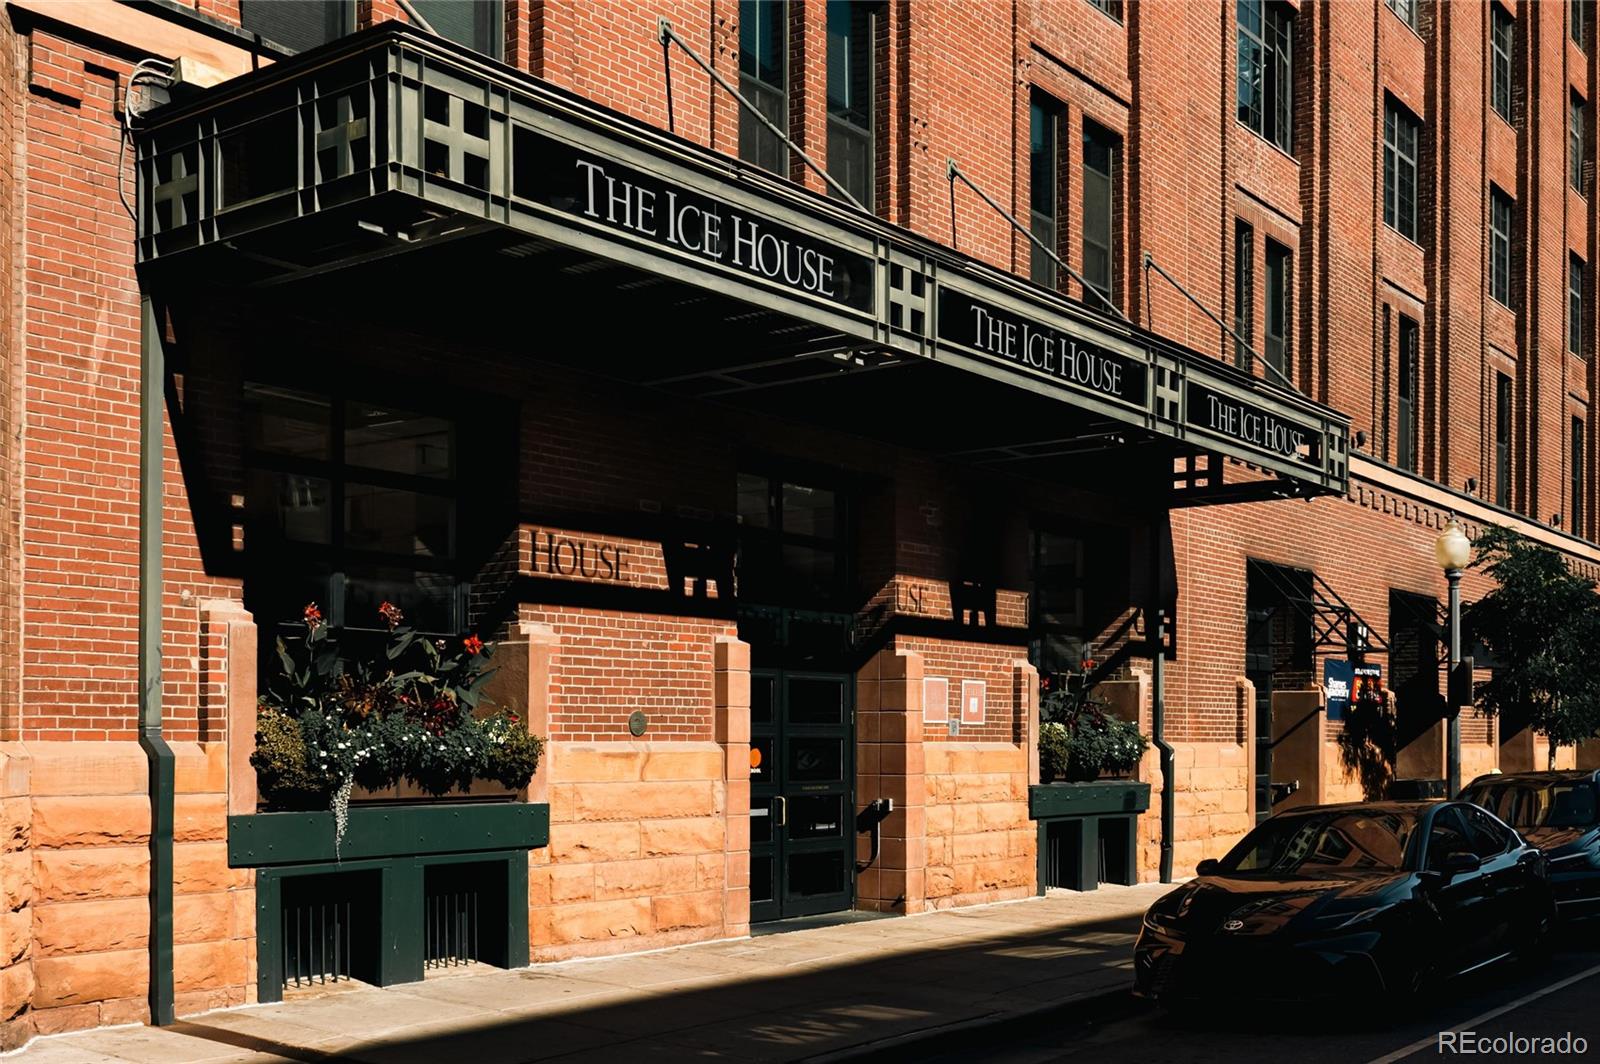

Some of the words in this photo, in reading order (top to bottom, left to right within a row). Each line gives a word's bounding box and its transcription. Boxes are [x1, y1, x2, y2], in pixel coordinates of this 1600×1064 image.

[576, 159, 657, 237] THE
[666, 190, 722, 258] ICE
[731, 215, 834, 297] HOUSE
[970, 305, 1017, 359] THE
[1022, 323, 1055, 373] ICE
[1060, 338, 1122, 396] HOUSE
[1207, 394, 1237, 435] THE
[1240, 406, 1261, 444] ICE
[529, 528, 632, 583] HOUSE
